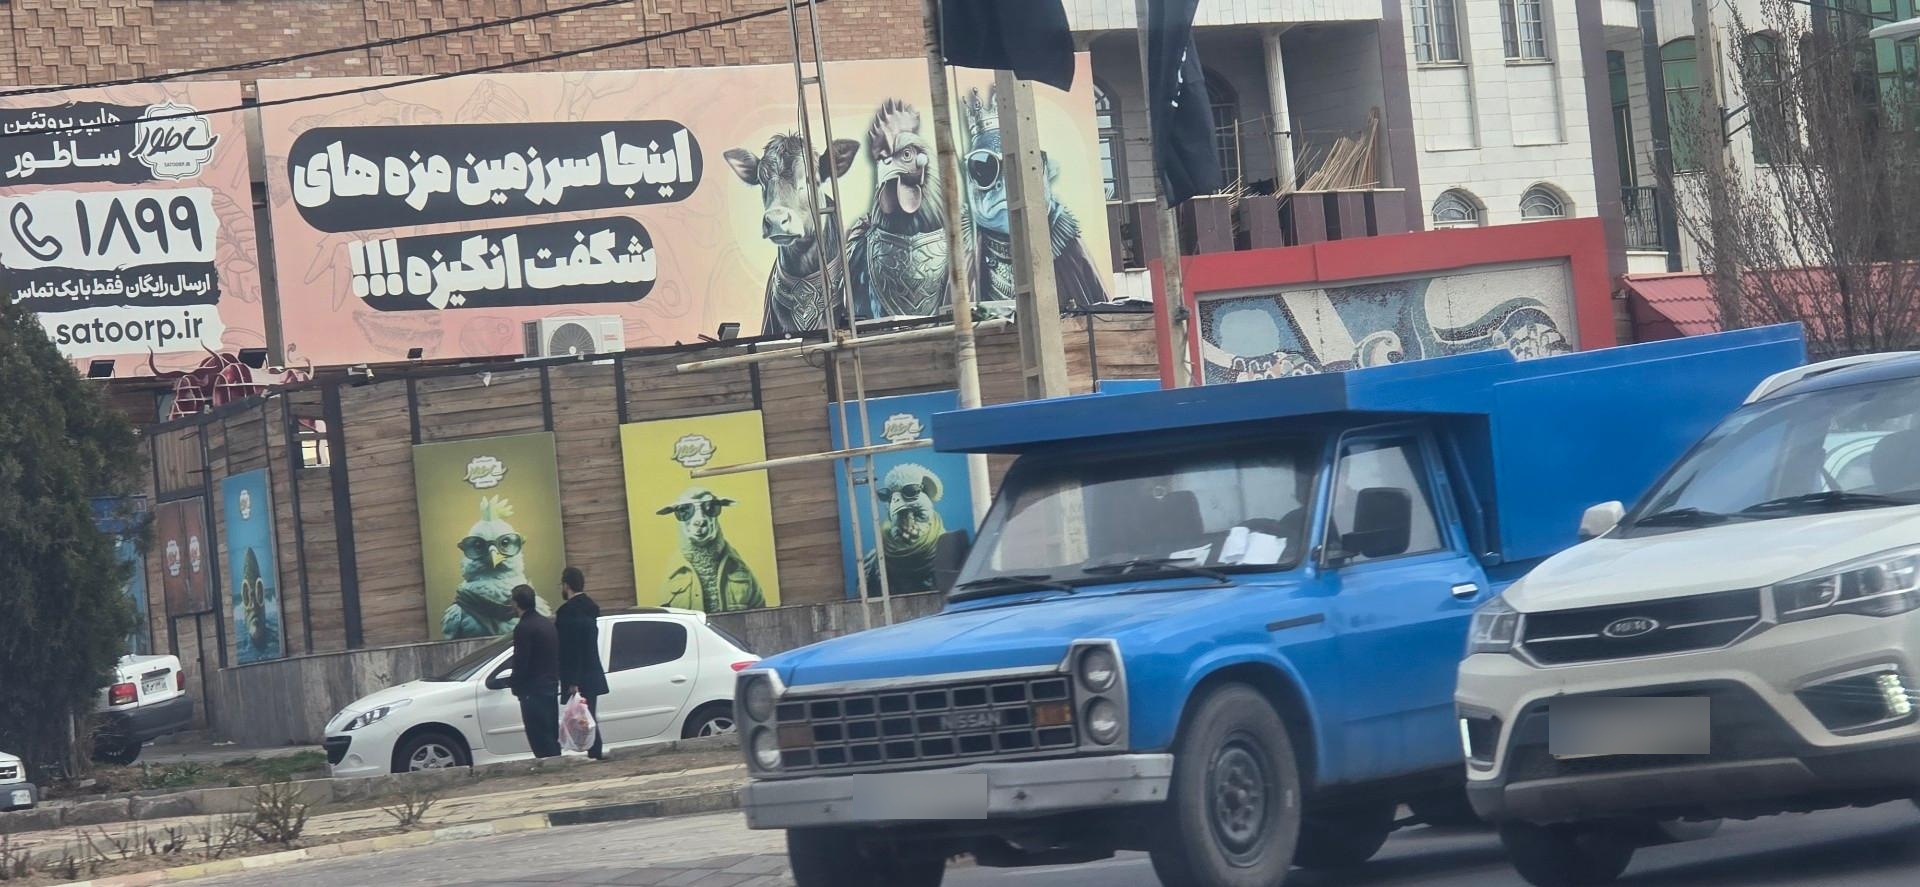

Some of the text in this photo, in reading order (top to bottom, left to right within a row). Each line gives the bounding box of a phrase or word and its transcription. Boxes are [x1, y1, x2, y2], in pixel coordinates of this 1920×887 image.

[4, 107, 121, 137] هایپر پروتئین
[5, 140, 121, 178] ساطور
[293, 127, 694, 211] اینجا سرزمین مزه های
[75, 195, 203, 257] ۱۸۹۹
[524, 228, 657, 288] شگفت
[12, 273, 211, 304] ارسال رایگان فقط با یک تماس
[56, 310, 203, 347] satoorp.ir
